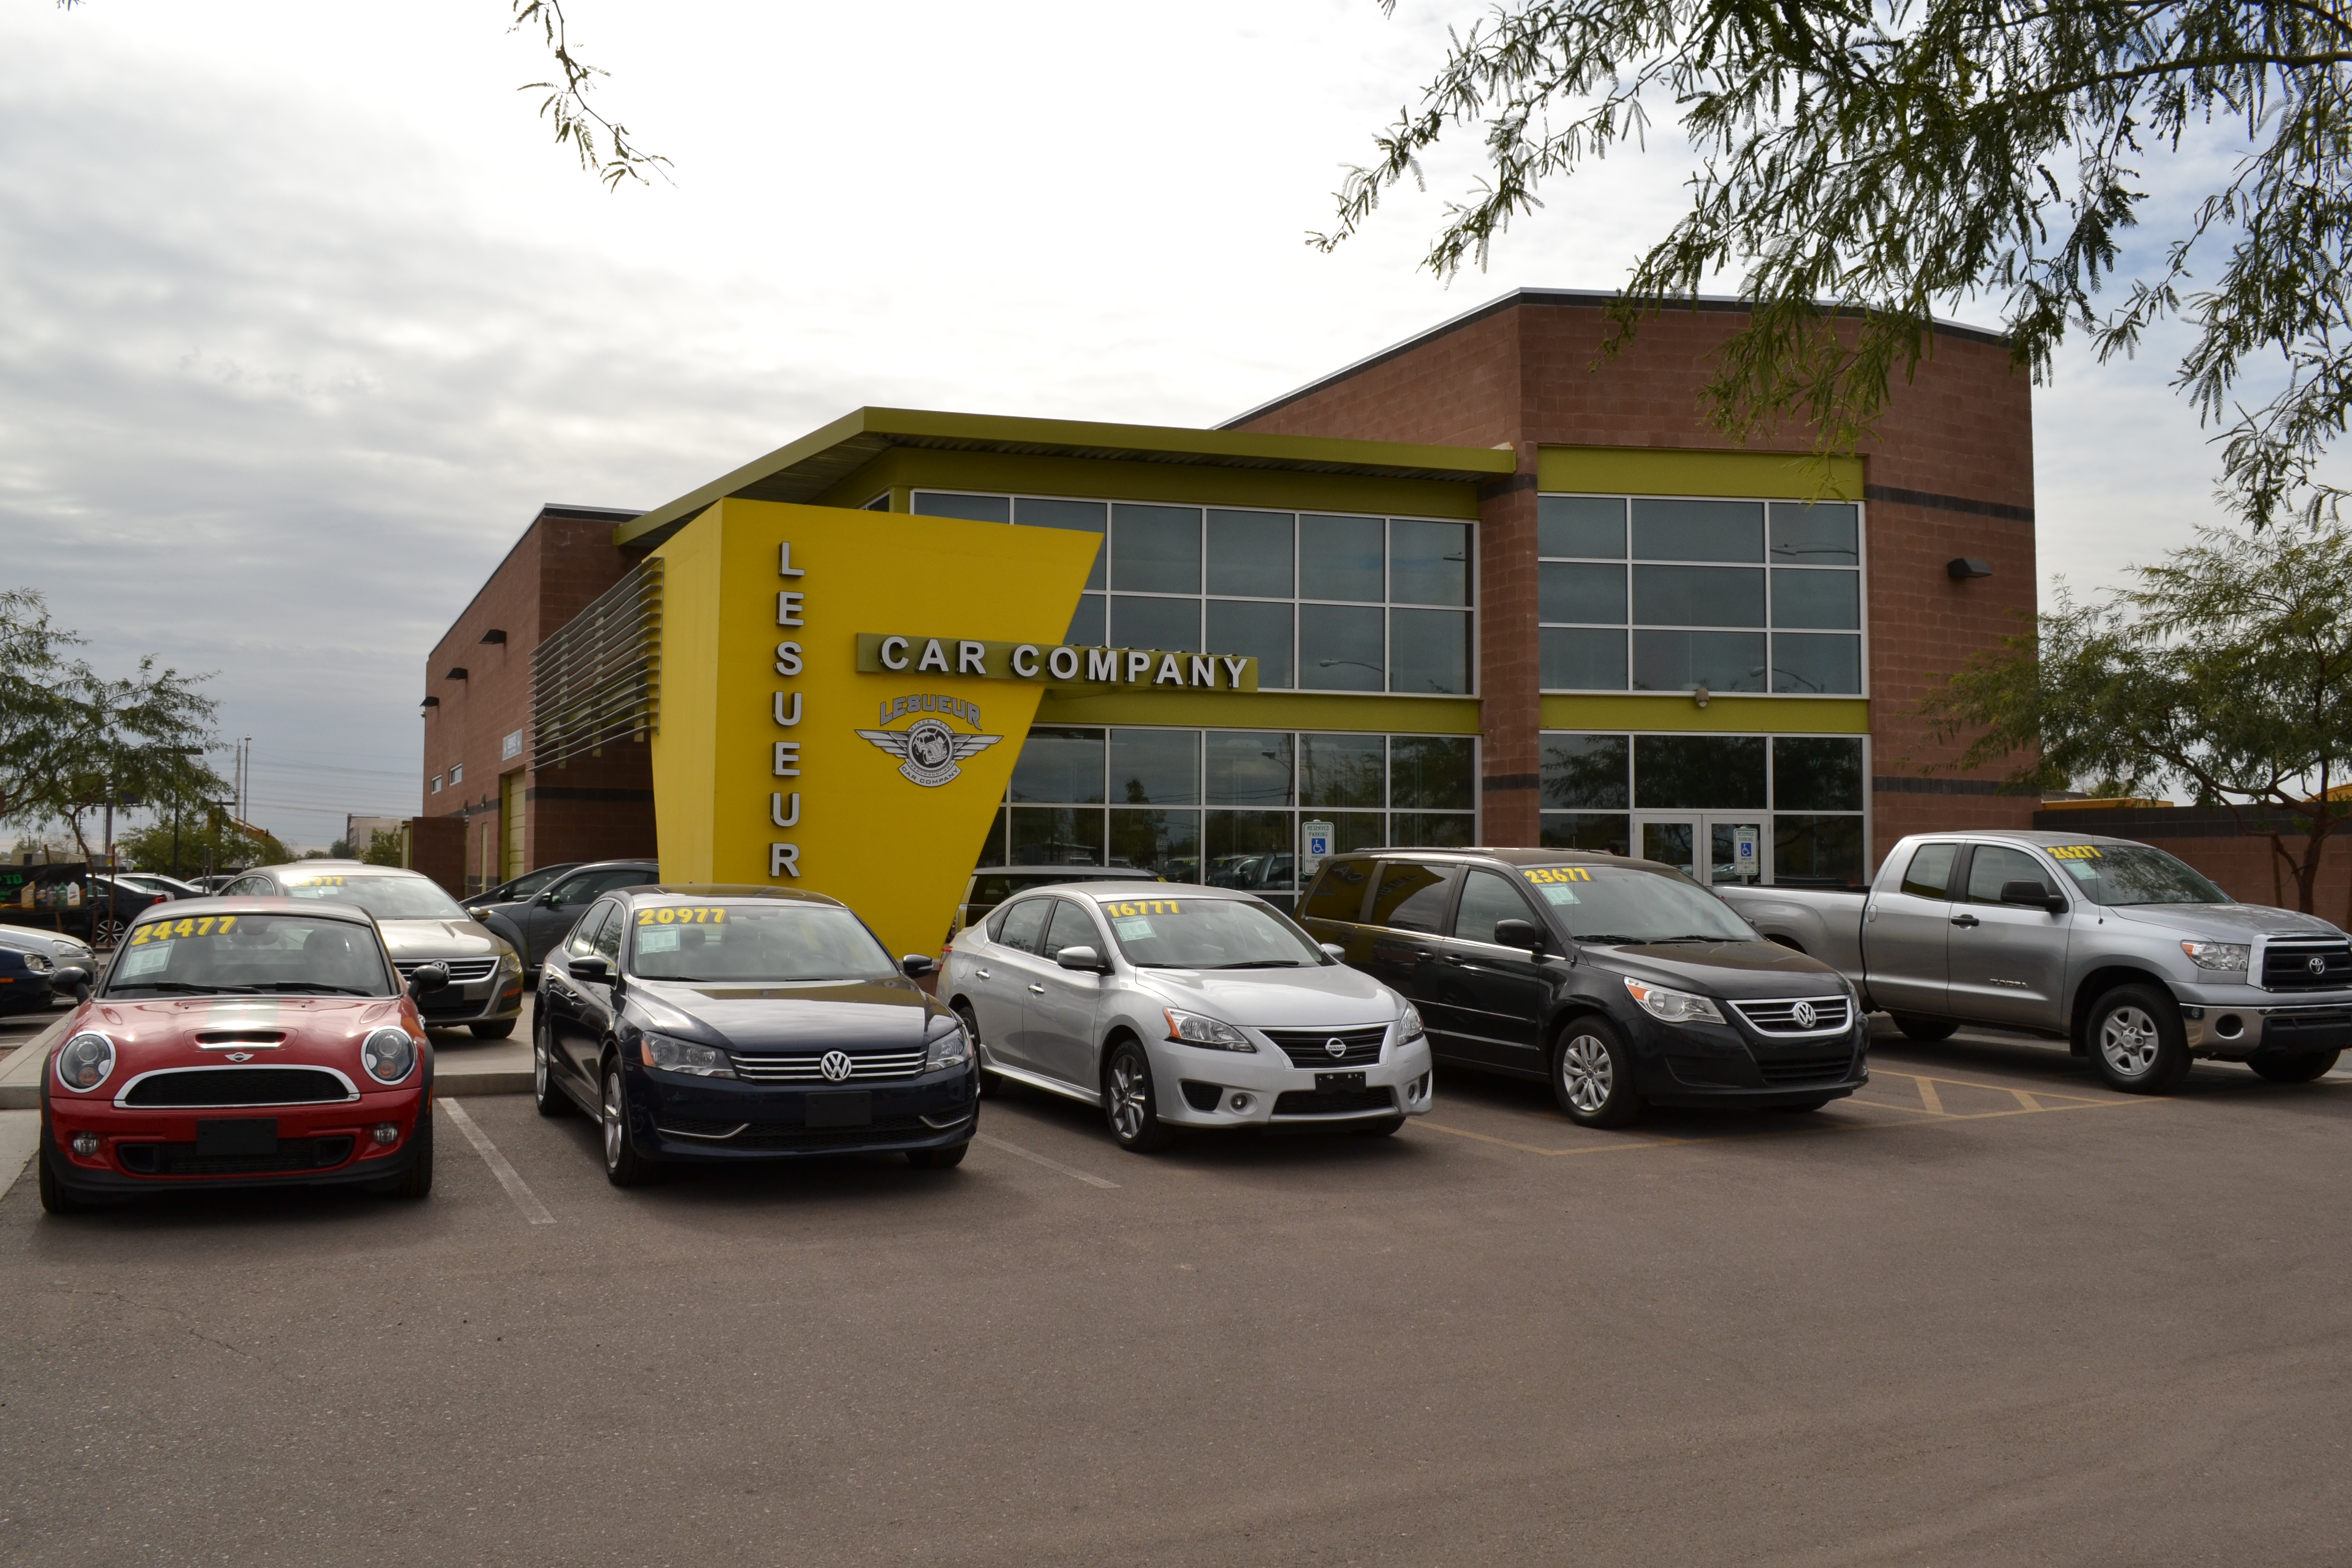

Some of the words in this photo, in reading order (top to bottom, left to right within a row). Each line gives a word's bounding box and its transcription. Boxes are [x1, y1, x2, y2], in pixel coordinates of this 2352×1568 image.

[879, 635, 987, 675] CAR
[1011, 644, 1248, 689] COMPANY
[770, 541, 805, 877] LESUEUR
[879, 694, 983, 731] LESUEUR
[911, 719, 930, 731] SINCE
[901, 766, 917, 780] CAR
[919, 767, 958, 785] COMPANY
[2047, 845, 2103, 859] 26277
[1524, 868, 1591, 884] 23677
[638, 908, 727, 925] 20977
[1107, 900, 1180, 918] 16777
[131, 916, 238, 946] 24477
